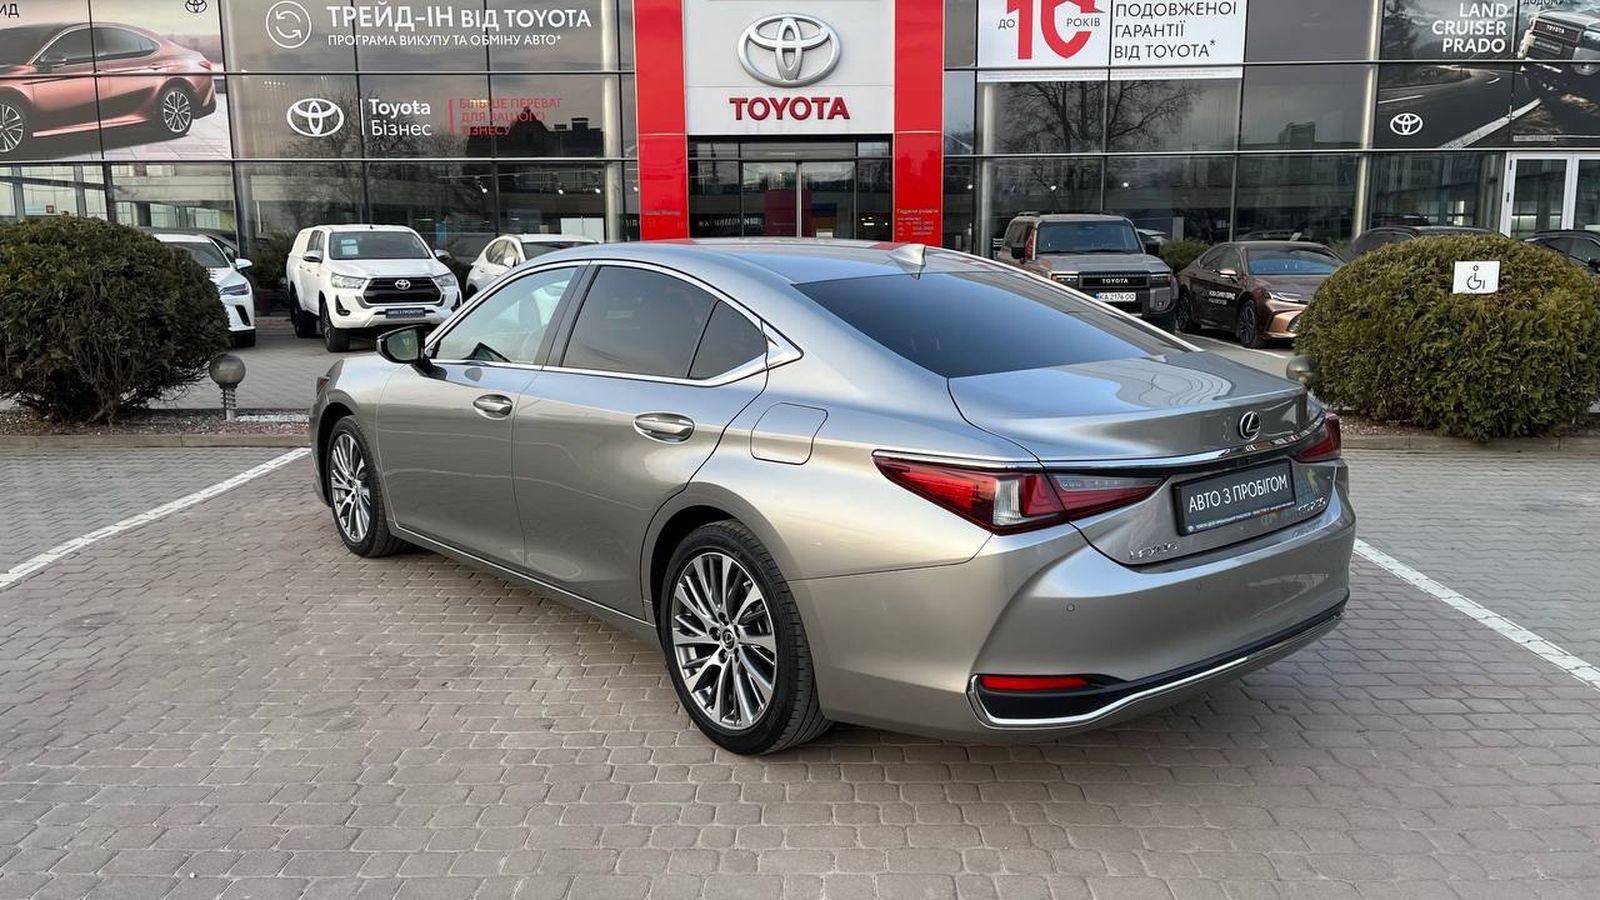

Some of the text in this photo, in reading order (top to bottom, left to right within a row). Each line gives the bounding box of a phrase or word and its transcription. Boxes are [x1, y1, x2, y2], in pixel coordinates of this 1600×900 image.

[326, 1, 592, 32] ТРЕЙД-ІН ВІД TOYOTA
[1459, 3, 1509, 18] LAND
[998, 18, 1016, 30] ДО
[1066, 17, 1101, 27] РОКІВ
[1115, 20, 1187, 38] ГАРАНТІЇ
[1432, 20, 1507, 35] CRUISER
[328, 34, 397, 46] ПРОГРАМА
[400, 34, 450, 46] ВИКУПУ
[453, 34, 468, 46] ТА
[470, 33, 521, 46] ОБМІНУ
[1442, 38, 1506, 53] PRADO
[1114, 45, 1141, 61] ВІД
[368, 98, 431, 118] Toyota
[729, 96, 851, 121] TOYOTA
[371, 120, 432, 136] Бізнес
[1188, 490, 1221, 514] АВТО
[1232, 474, 1289, 502] ПРОБІГОМ
